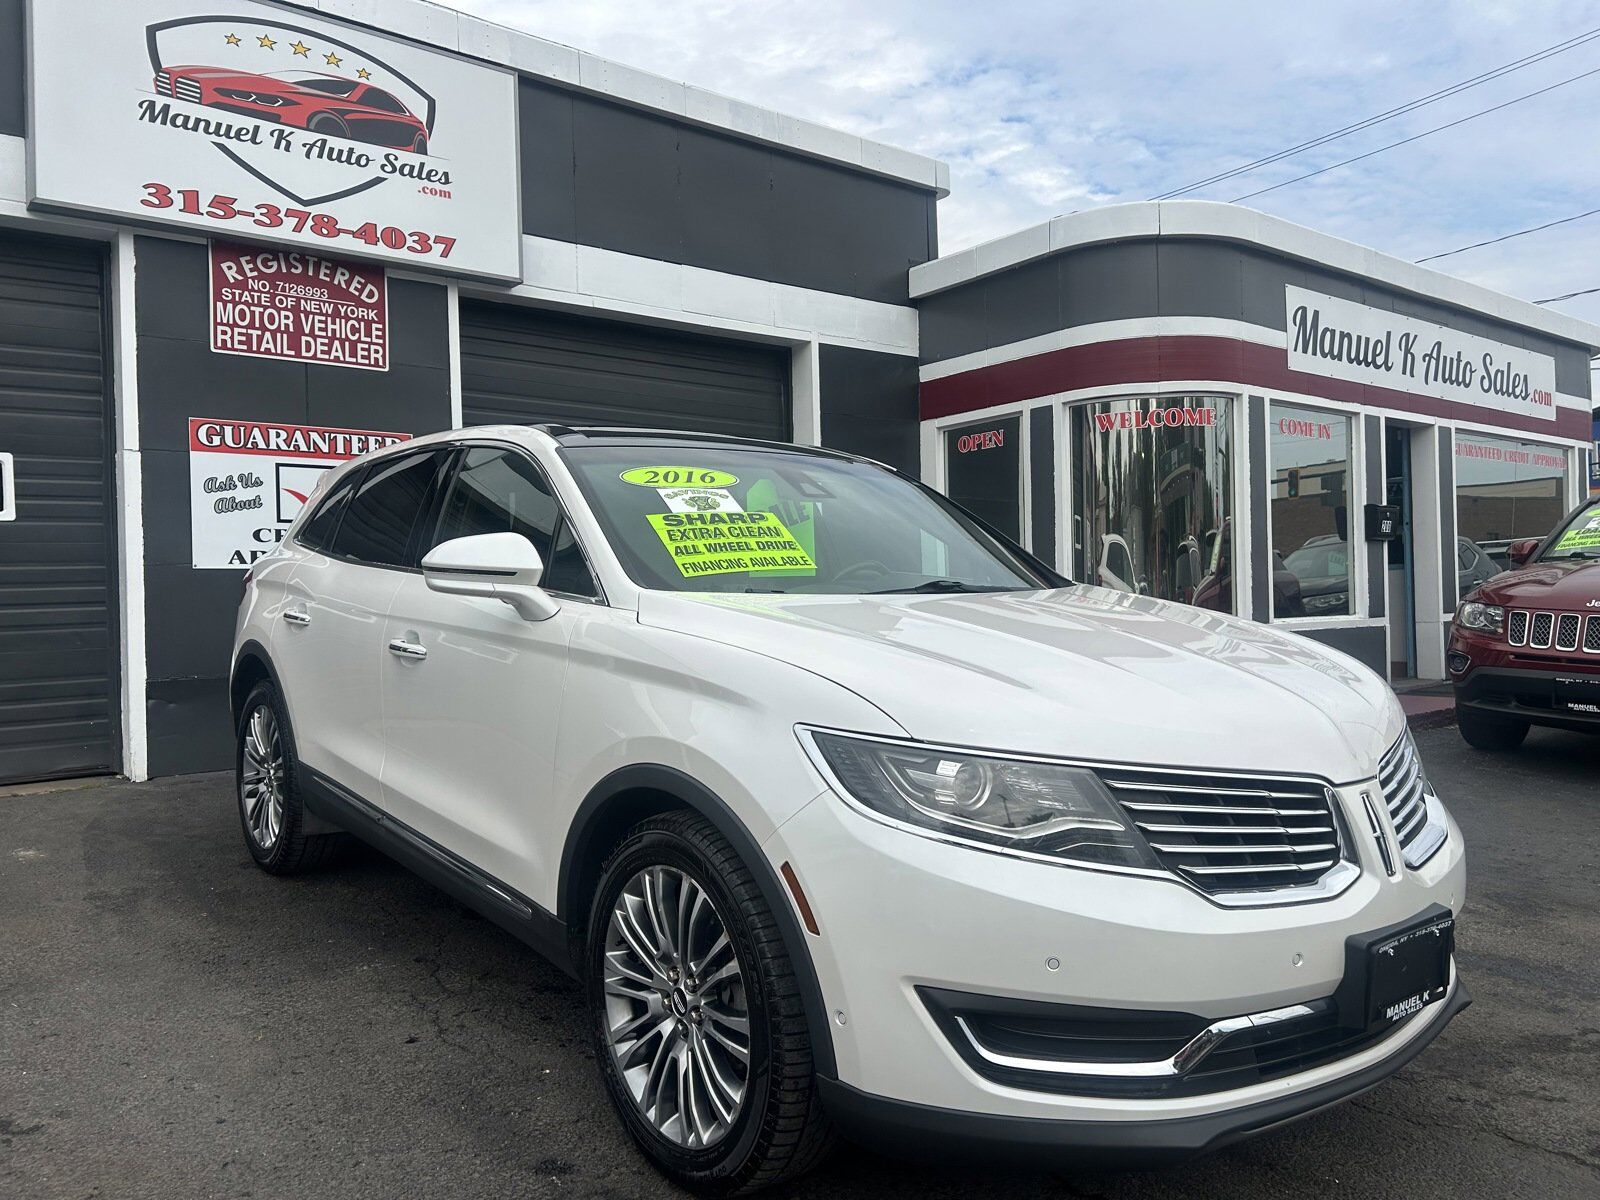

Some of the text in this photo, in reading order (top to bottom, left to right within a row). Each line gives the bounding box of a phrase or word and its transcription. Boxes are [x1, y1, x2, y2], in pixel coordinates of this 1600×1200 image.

[138, 99, 452, 186] Manuel K Auto Sales
[417, 185, 451, 200] .com
[140, 183, 457, 259] 315-378-4037
[220, 252, 379, 304] REGISTERED
[248, 279, 329, 299] NO. 7126993
[221, 288, 379, 321] STATE OF NEW YORK
[216, 301, 384, 344] MOTOR VEHICLE
[216, 325, 384, 366] RETAIL DEALER
[1292, 305, 1531, 401] Manuel K Auto Sales
[1530, 391, 1553, 407] .com
[1095, 407, 1217, 433] WELCOME
[1279, 416, 1331, 440] COME IN
[957, 429, 1004, 454] OPEN
[203, 473, 263, 494] Ask Us
[643, 470, 716, 484] 2016
[214, 495, 263, 514] About
[662, 513, 768, 527] SHARP
[666, 526, 783, 542] EXTRA CLEAN
[674, 540, 799, 556] ALL WHEEL DRIVE
[681, 556, 812, 574] FINANCING AVAILABLE
[1386, 990, 1430, 1018] MANUEL K
[1392, 1003, 1423, 1021] AUTO SALES
